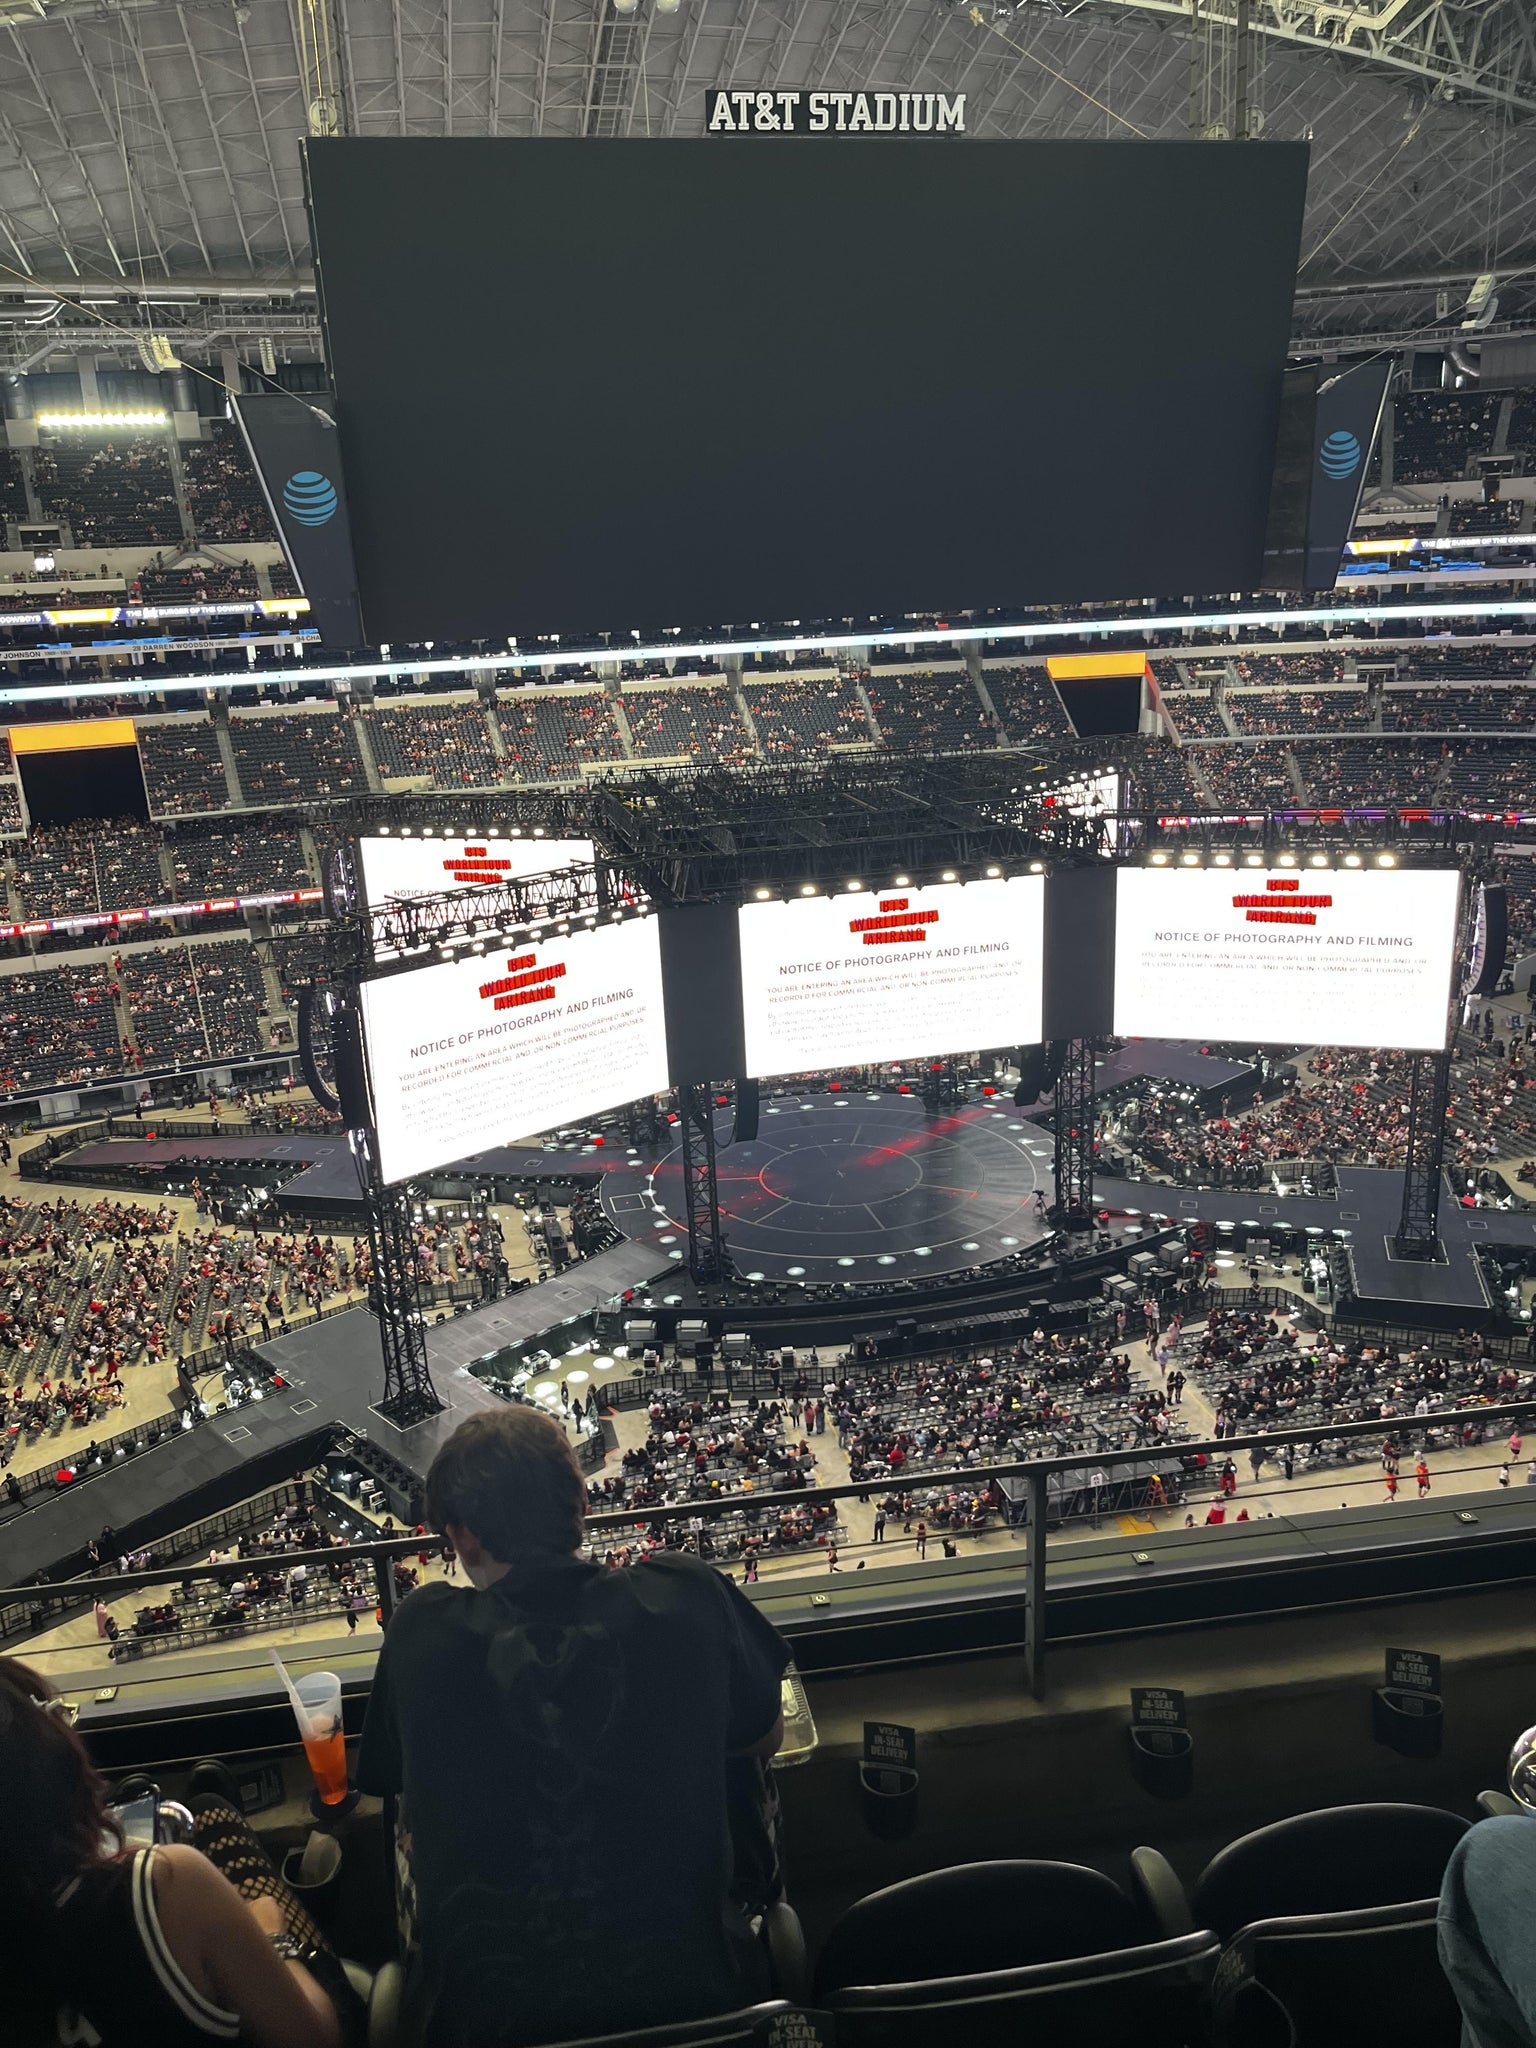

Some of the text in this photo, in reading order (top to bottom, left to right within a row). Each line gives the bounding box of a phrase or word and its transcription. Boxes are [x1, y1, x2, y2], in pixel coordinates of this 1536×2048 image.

[709, 92, 966, 131] AT&T STADIUM
[159, 608, 189, 616] BURGER
[218, 604, 254, 612] COWBOYS
[466, 847, 486, 857] BTS
[446, 859, 508, 870] WORLD TOUR
[457, 872, 500, 882] ARIRANG
[1269, 879, 1297, 892] BTS
[394, 890, 424, 898] NOTICE
[210, 901, 234, 910] Lenovo
[882, 898, 907, 912] BTS
[1238, 894, 1328, 908] WORLD TOUR
[118, 912, 143, 921] Lenovo
[854, 910, 935, 932] WORLD TOUR
[1250, 910, 1314, 924] ARIRANG
[20, 923, 48, 932] Lenovo
[867, 928, 923, 946] ARIRANG
[1154, 931, 1412, 946] NOTICE OF PHOTOGRAPHY AND FILMING
[510, 954, 536, 972] BTS
[779, 942, 1009, 974] NOTICE OF PHOTOGRAPHY AND FILMING
[484, 964, 562, 997] WORLD TOUR
[801, 979, 838, 989] ENTERING
[498, 984, 553, 1010] ARIRANG
[410, 988, 634, 1058] NOTICE OF PHOTOGRAPHY AND FILMING
[398, 1070, 415, 1082] YOU
[417, 1066, 432, 1076] ARE
[434, 1054, 473, 1071] ENTERING
[475, 1050, 486, 1060] AN
[488, 1044, 507, 1056] AREA
[509, 1037, 533, 1050] WHICH
[534, 1032, 552, 1043] WILL
[553, 1029, 561, 1038] BE
[563, 1013, 618, 1035] PHOTOGRAPHED
[401, 1017, 644, 1092] RECORDED FOR COMMERCIAL AND OR NON COMMERCIAL PURPOSES
[1400, 1652, 1424, 1662] VISA
[1396, 1661, 1430, 1674] IN-SEAT
[1392, 1671, 1432, 1686] DELIVERY
[1145, 1690, 1168, 1699] VISA
[1142, 1699, 1174, 1710] IN-SEAT
[1139, 1710, 1179, 1720] DELIVERY
[878, 1726, 900, 1736] VISA
[874, 1735, 904, 1748] IN-SEAT
[871, 1746, 908, 1759] DELIVERY
[774, 2014, 808, 2027] VISA
[768, 2026, 817, 2045] IN-SEAT
